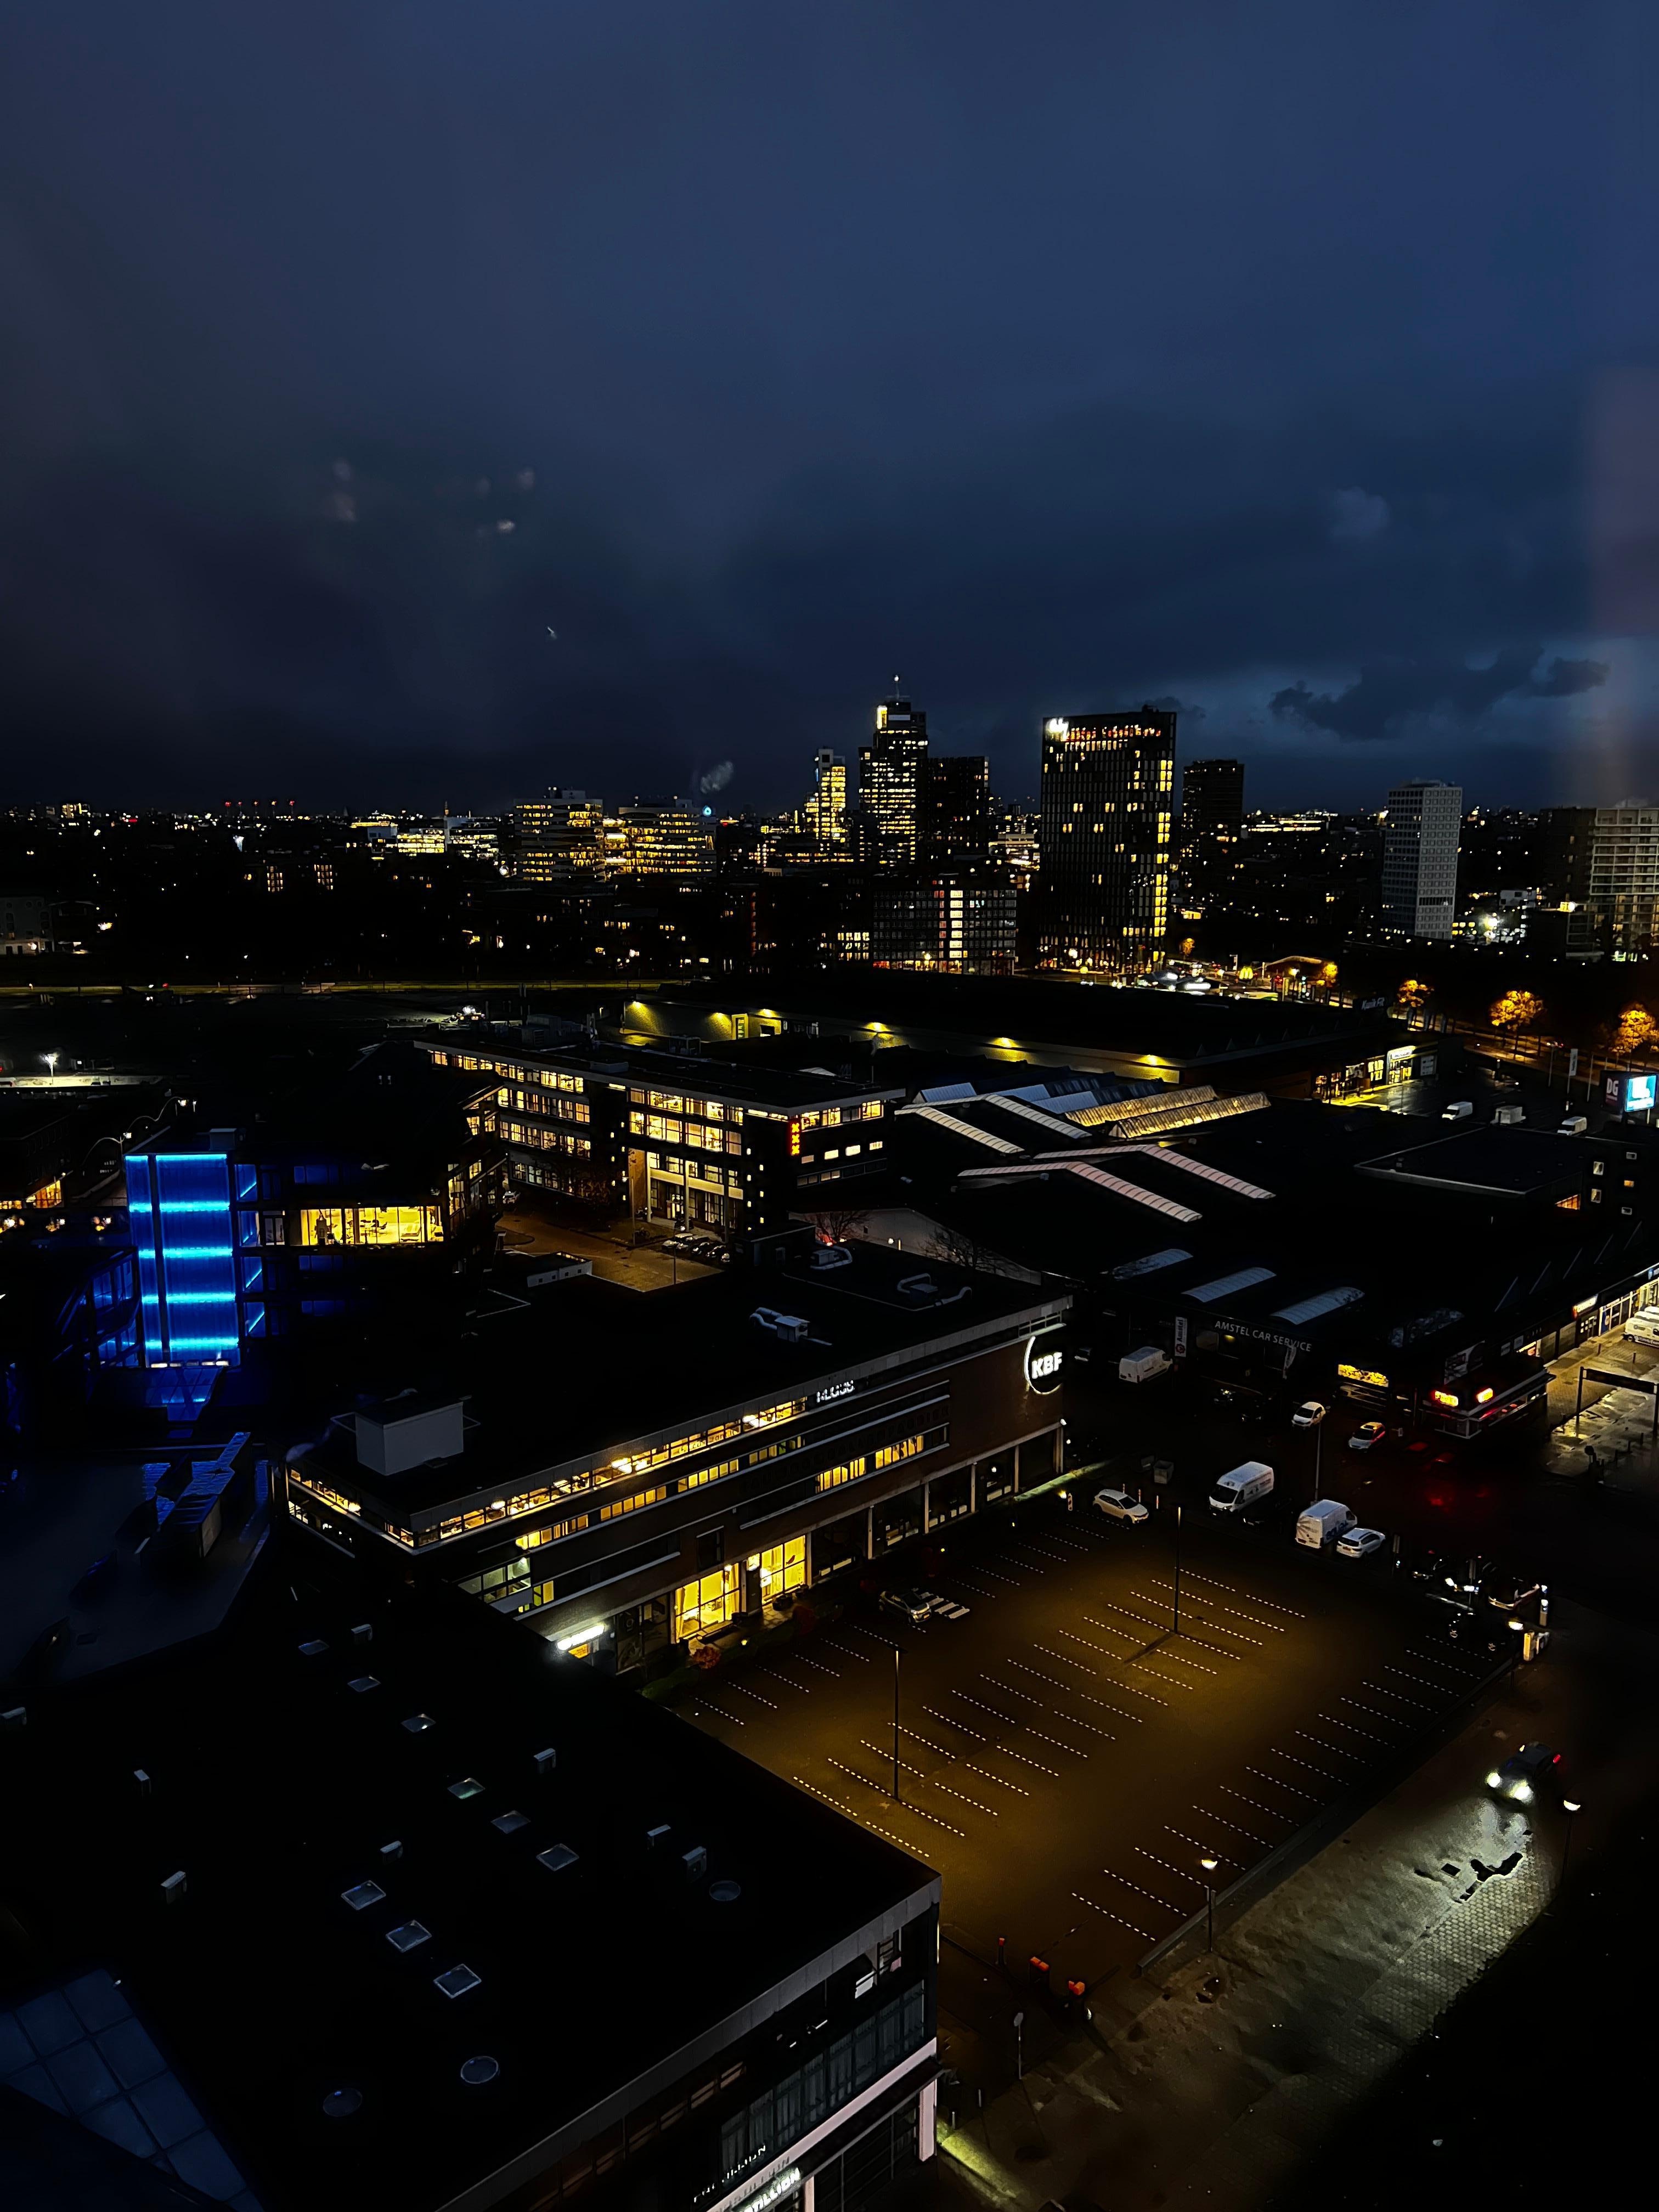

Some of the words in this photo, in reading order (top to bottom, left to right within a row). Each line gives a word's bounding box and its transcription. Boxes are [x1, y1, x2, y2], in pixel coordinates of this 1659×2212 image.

[1606, 1077, 1619, 1096] DG
[1214, 1321, 1250, 1337] AMSTEL
[1252, 1330, 1271, 1342] CAR
[1272, 1335, 1313, 1352] SERVICE
[1032, 1352, 1063, 1379] KBF
